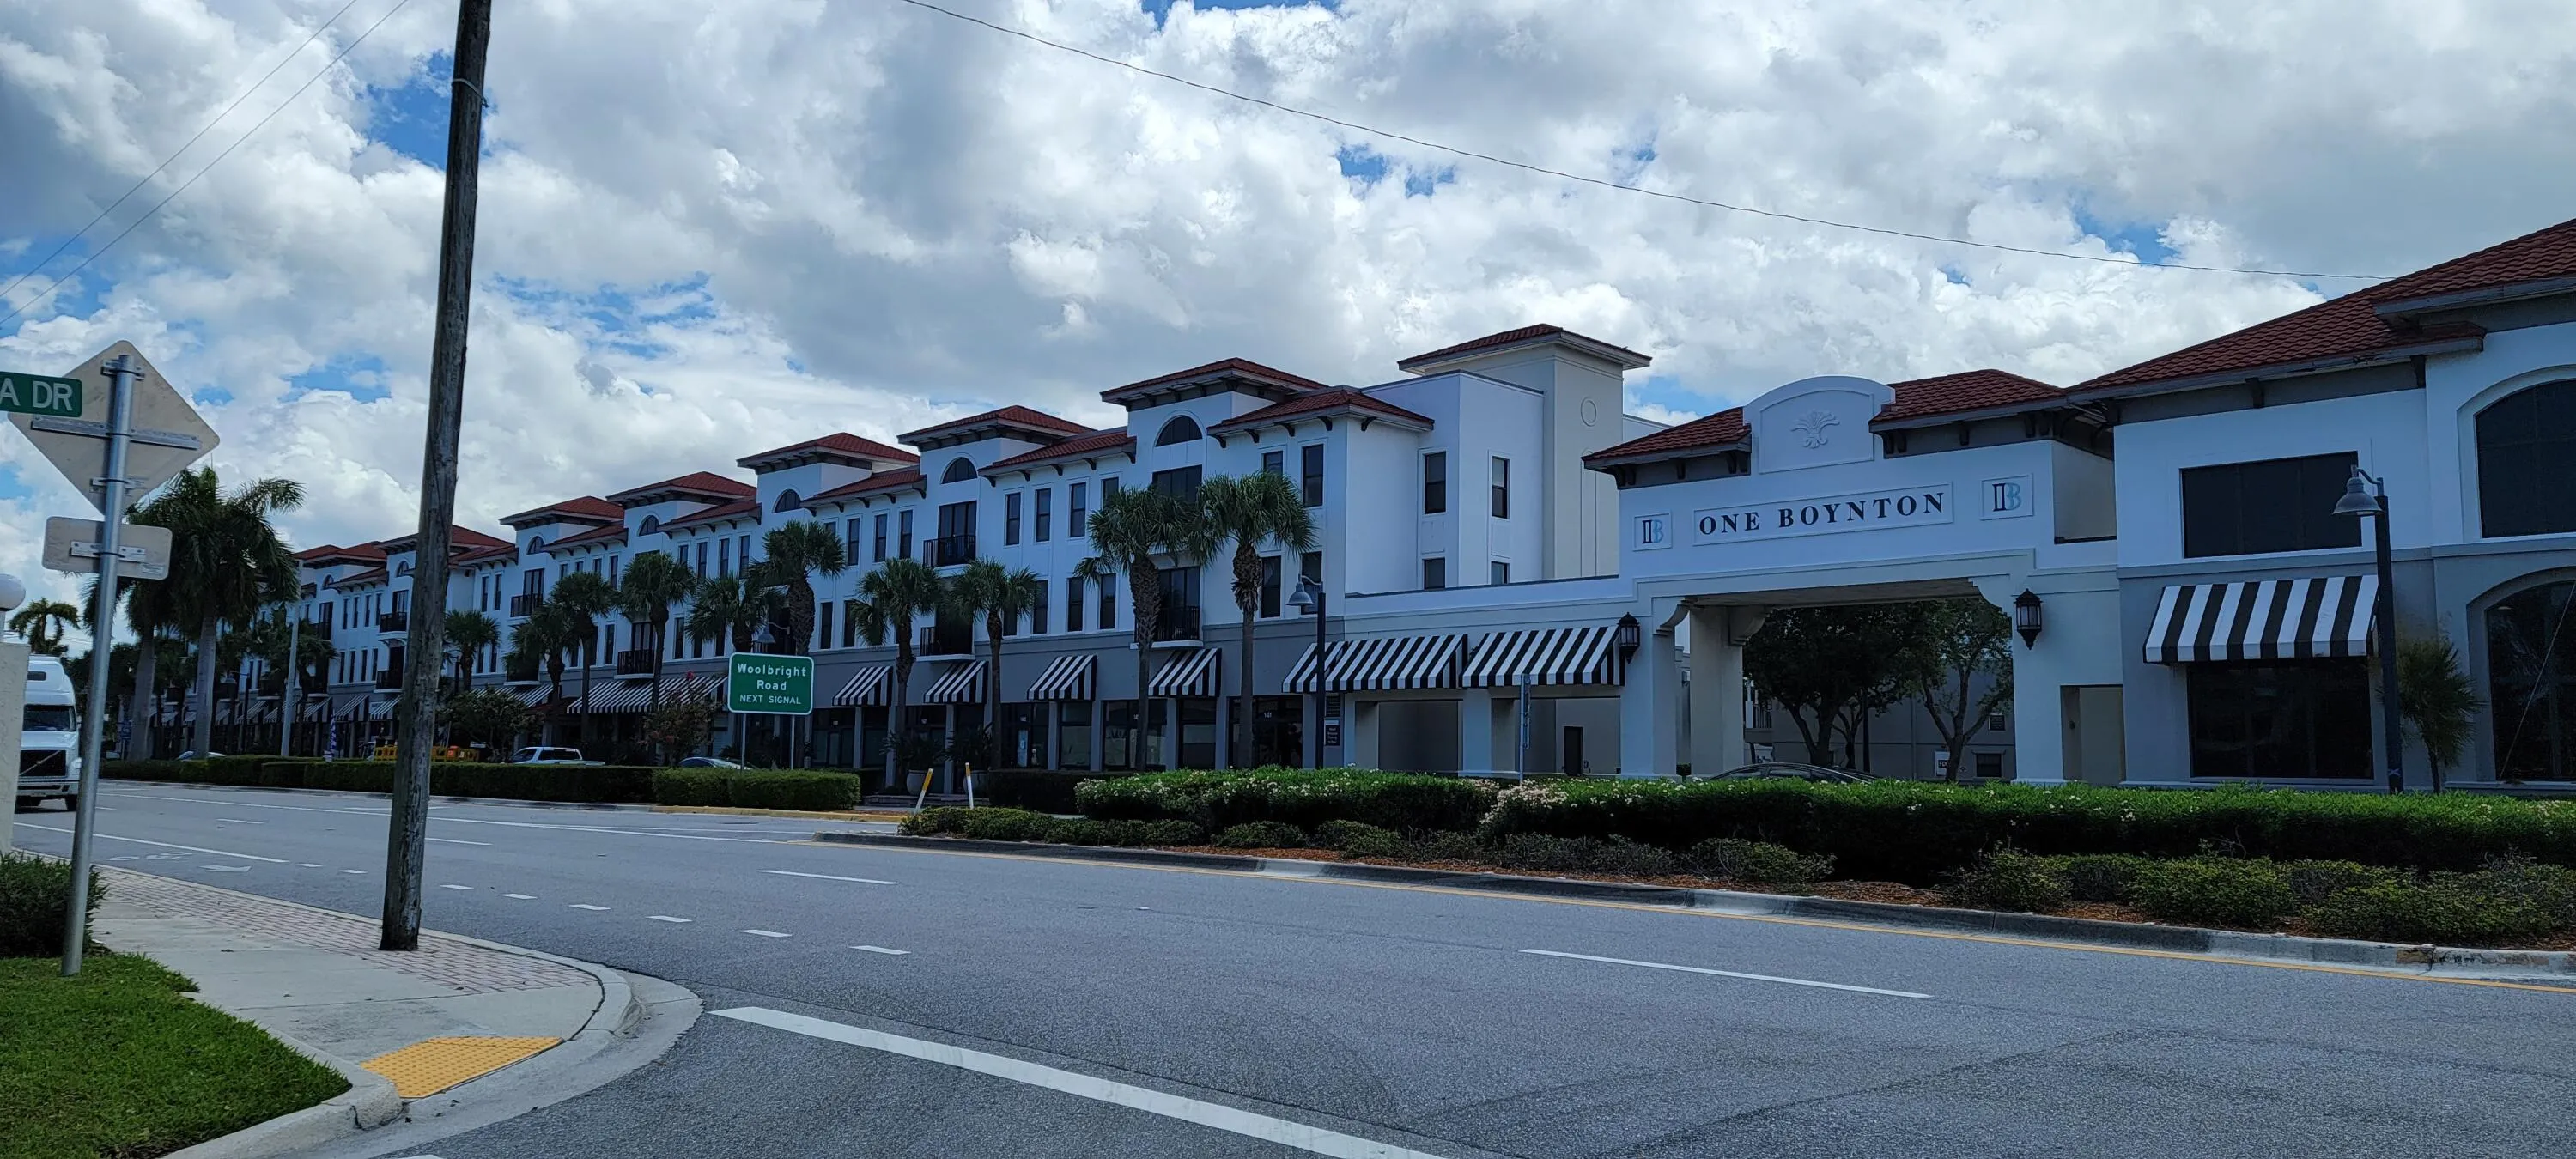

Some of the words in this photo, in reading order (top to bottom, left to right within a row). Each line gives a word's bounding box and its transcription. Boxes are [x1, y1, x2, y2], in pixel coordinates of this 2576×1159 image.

[0, 378, 21, 406] A
[33, 380, 73, 411] DR
[1699, 512, 1760, 535] ONE
[1778, 492, 1944, 528] BOYNTON
[737, 663, 806, 678] Woolbright
[756, 679, 787, 690] Road
[739, 694, 763, 703] NEXT
[769, 695, 801, 705] SIGNAL
